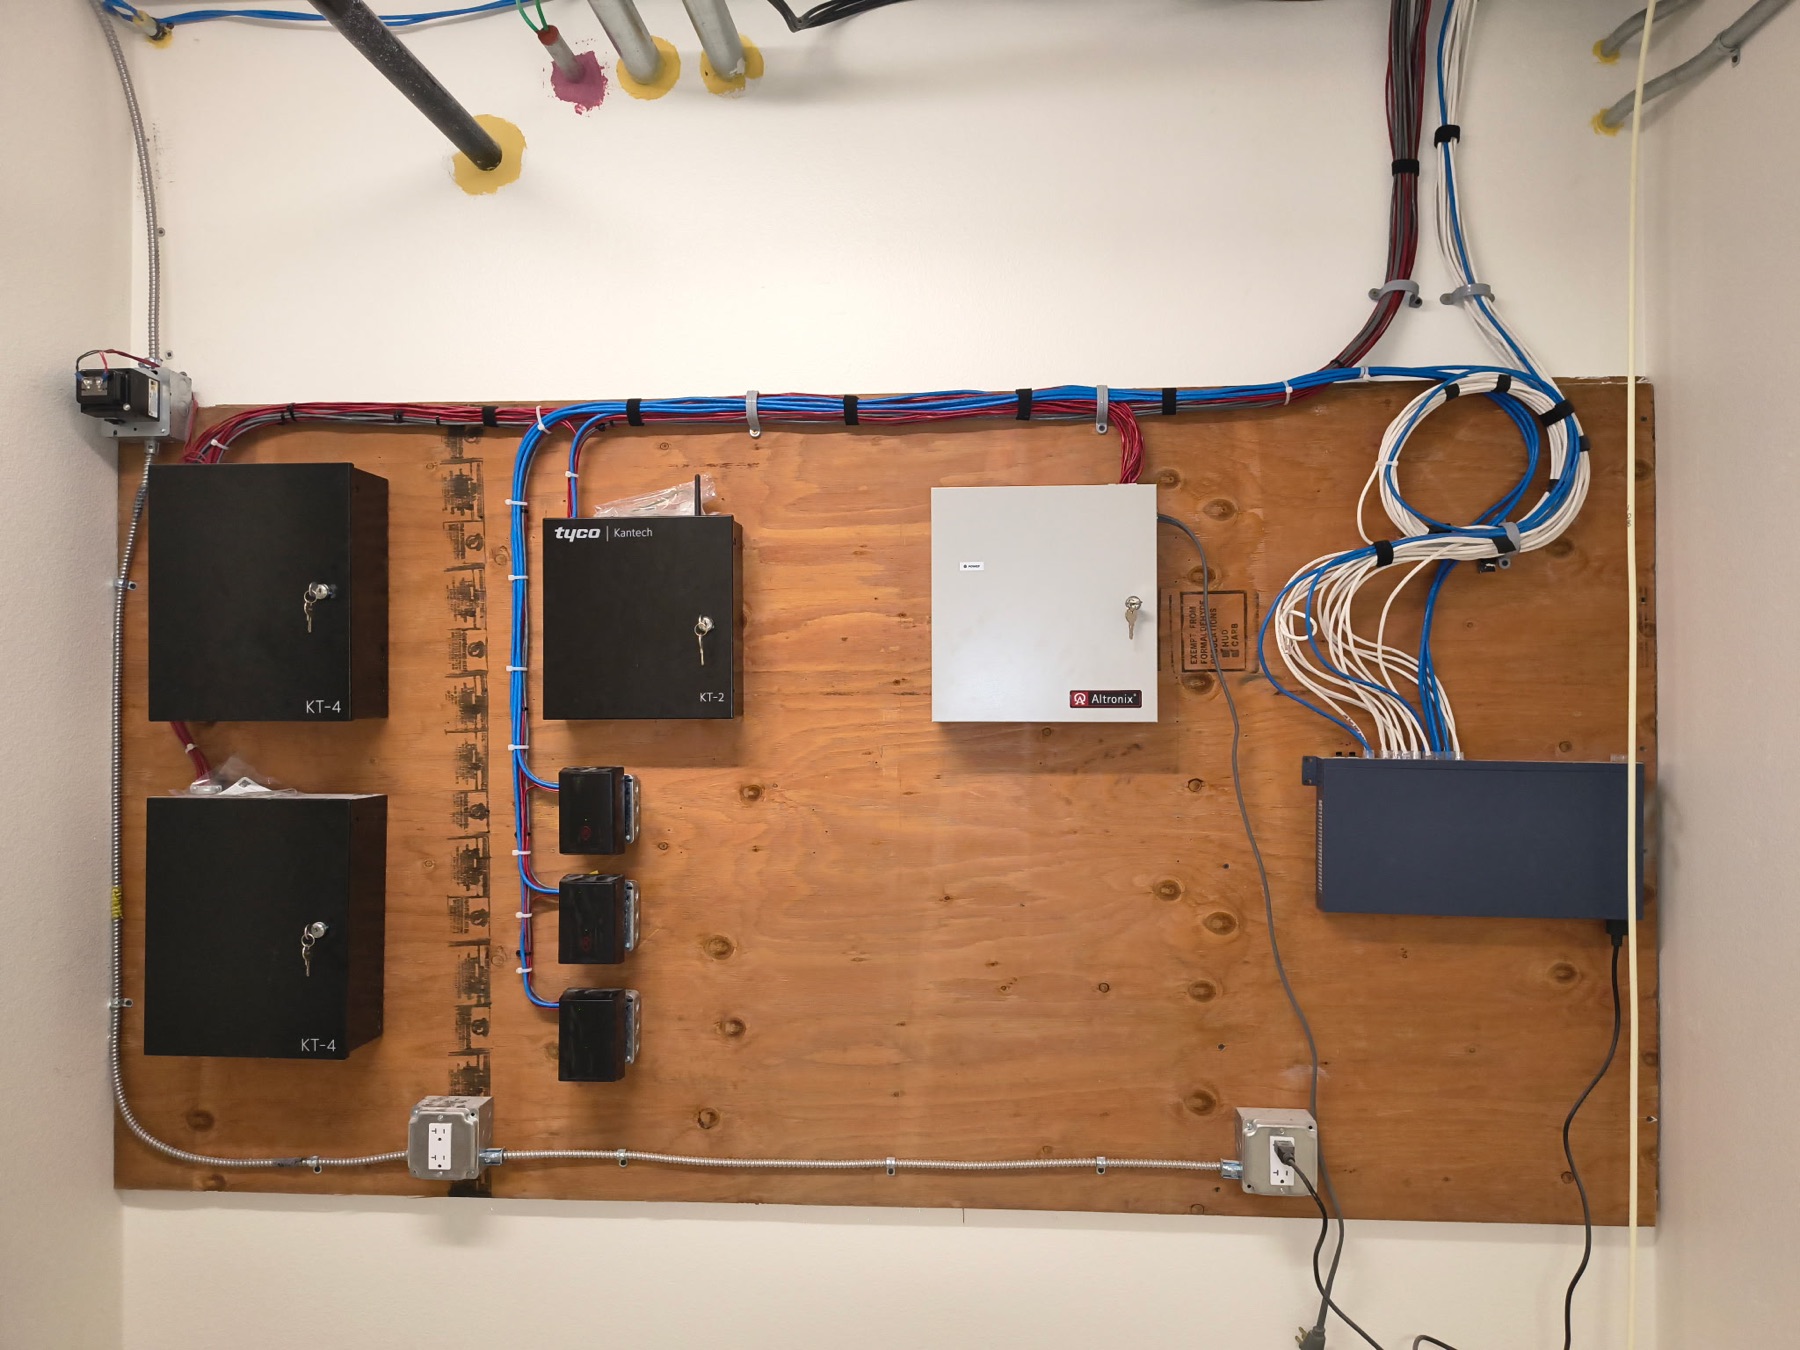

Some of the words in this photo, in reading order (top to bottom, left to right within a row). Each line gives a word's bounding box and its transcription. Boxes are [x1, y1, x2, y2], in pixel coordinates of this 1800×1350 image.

[554, 526, 601, 543] tyco
[613, 527, 653, 538] Kantech
[1188, 606, 1197, 629] FROM
[1221, 629, 1229, 648] HUD
[1231, 623, 1239, 647] CARB
[1189, 633, 1198, 665] EXEMPT
[699, 692, 725, 702] KT-2
[306, 699, 342, 714] KT-4
[301, 1038, 337, 1052] KT-4
